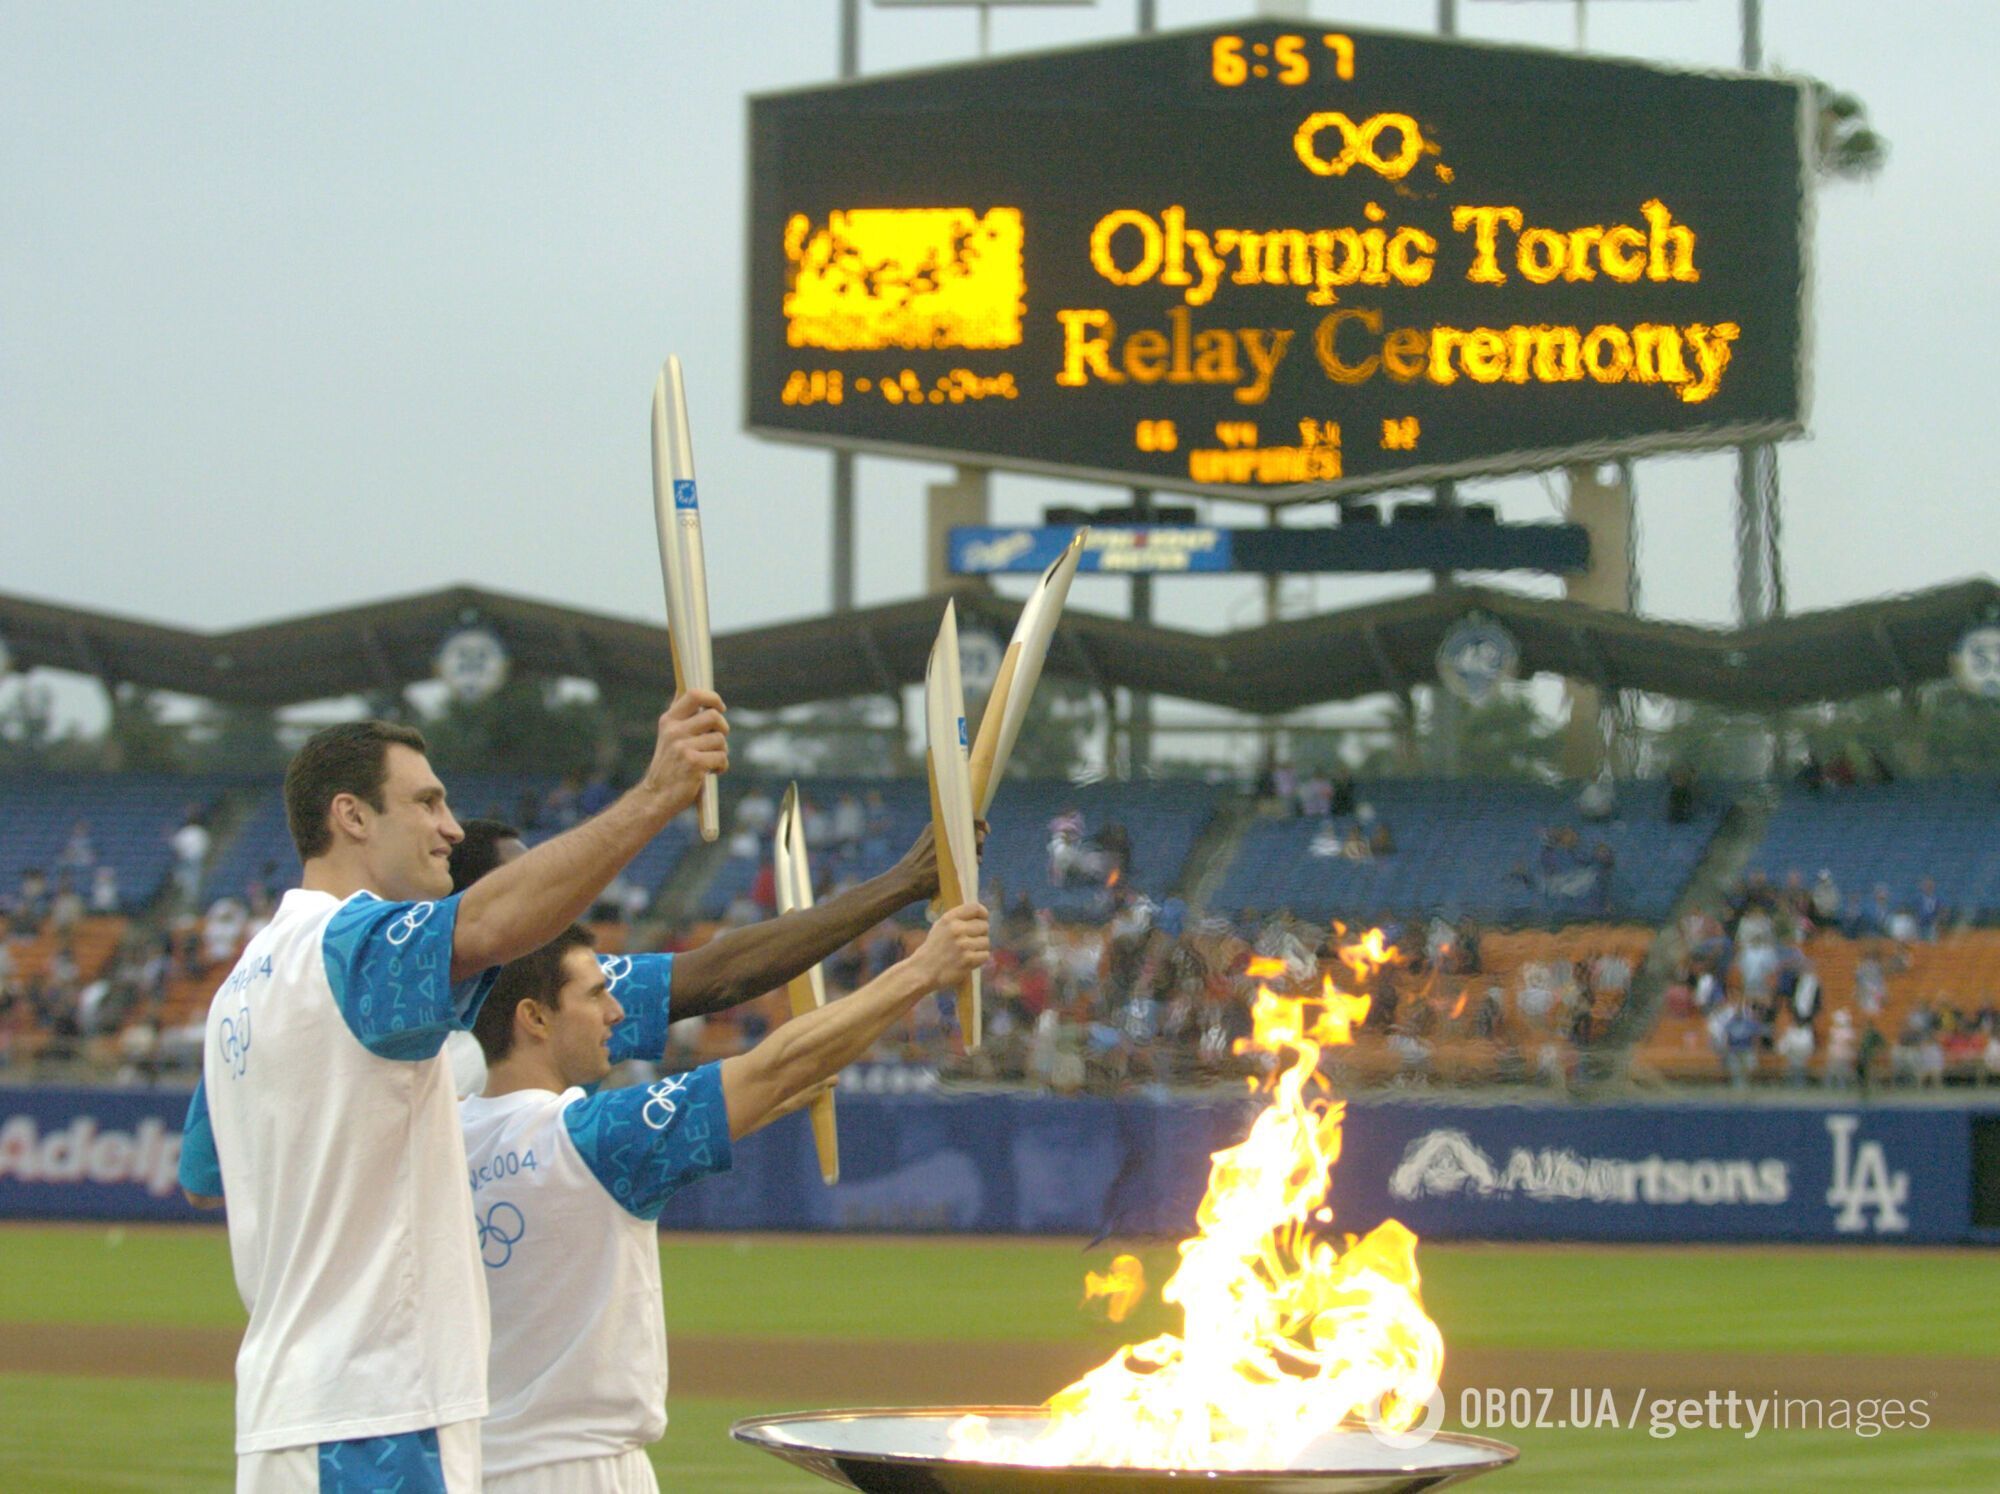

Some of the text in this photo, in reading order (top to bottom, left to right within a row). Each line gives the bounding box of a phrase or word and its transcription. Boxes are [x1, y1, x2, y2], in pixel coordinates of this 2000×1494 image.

[1212, 34, 1355, 86] 6:57
[1090, 199, 1701, 305] Olympic Torch
[1056, 306, 1741, 404] Relay Ceremony
[1827, 1114, 1909, 1232] LA
